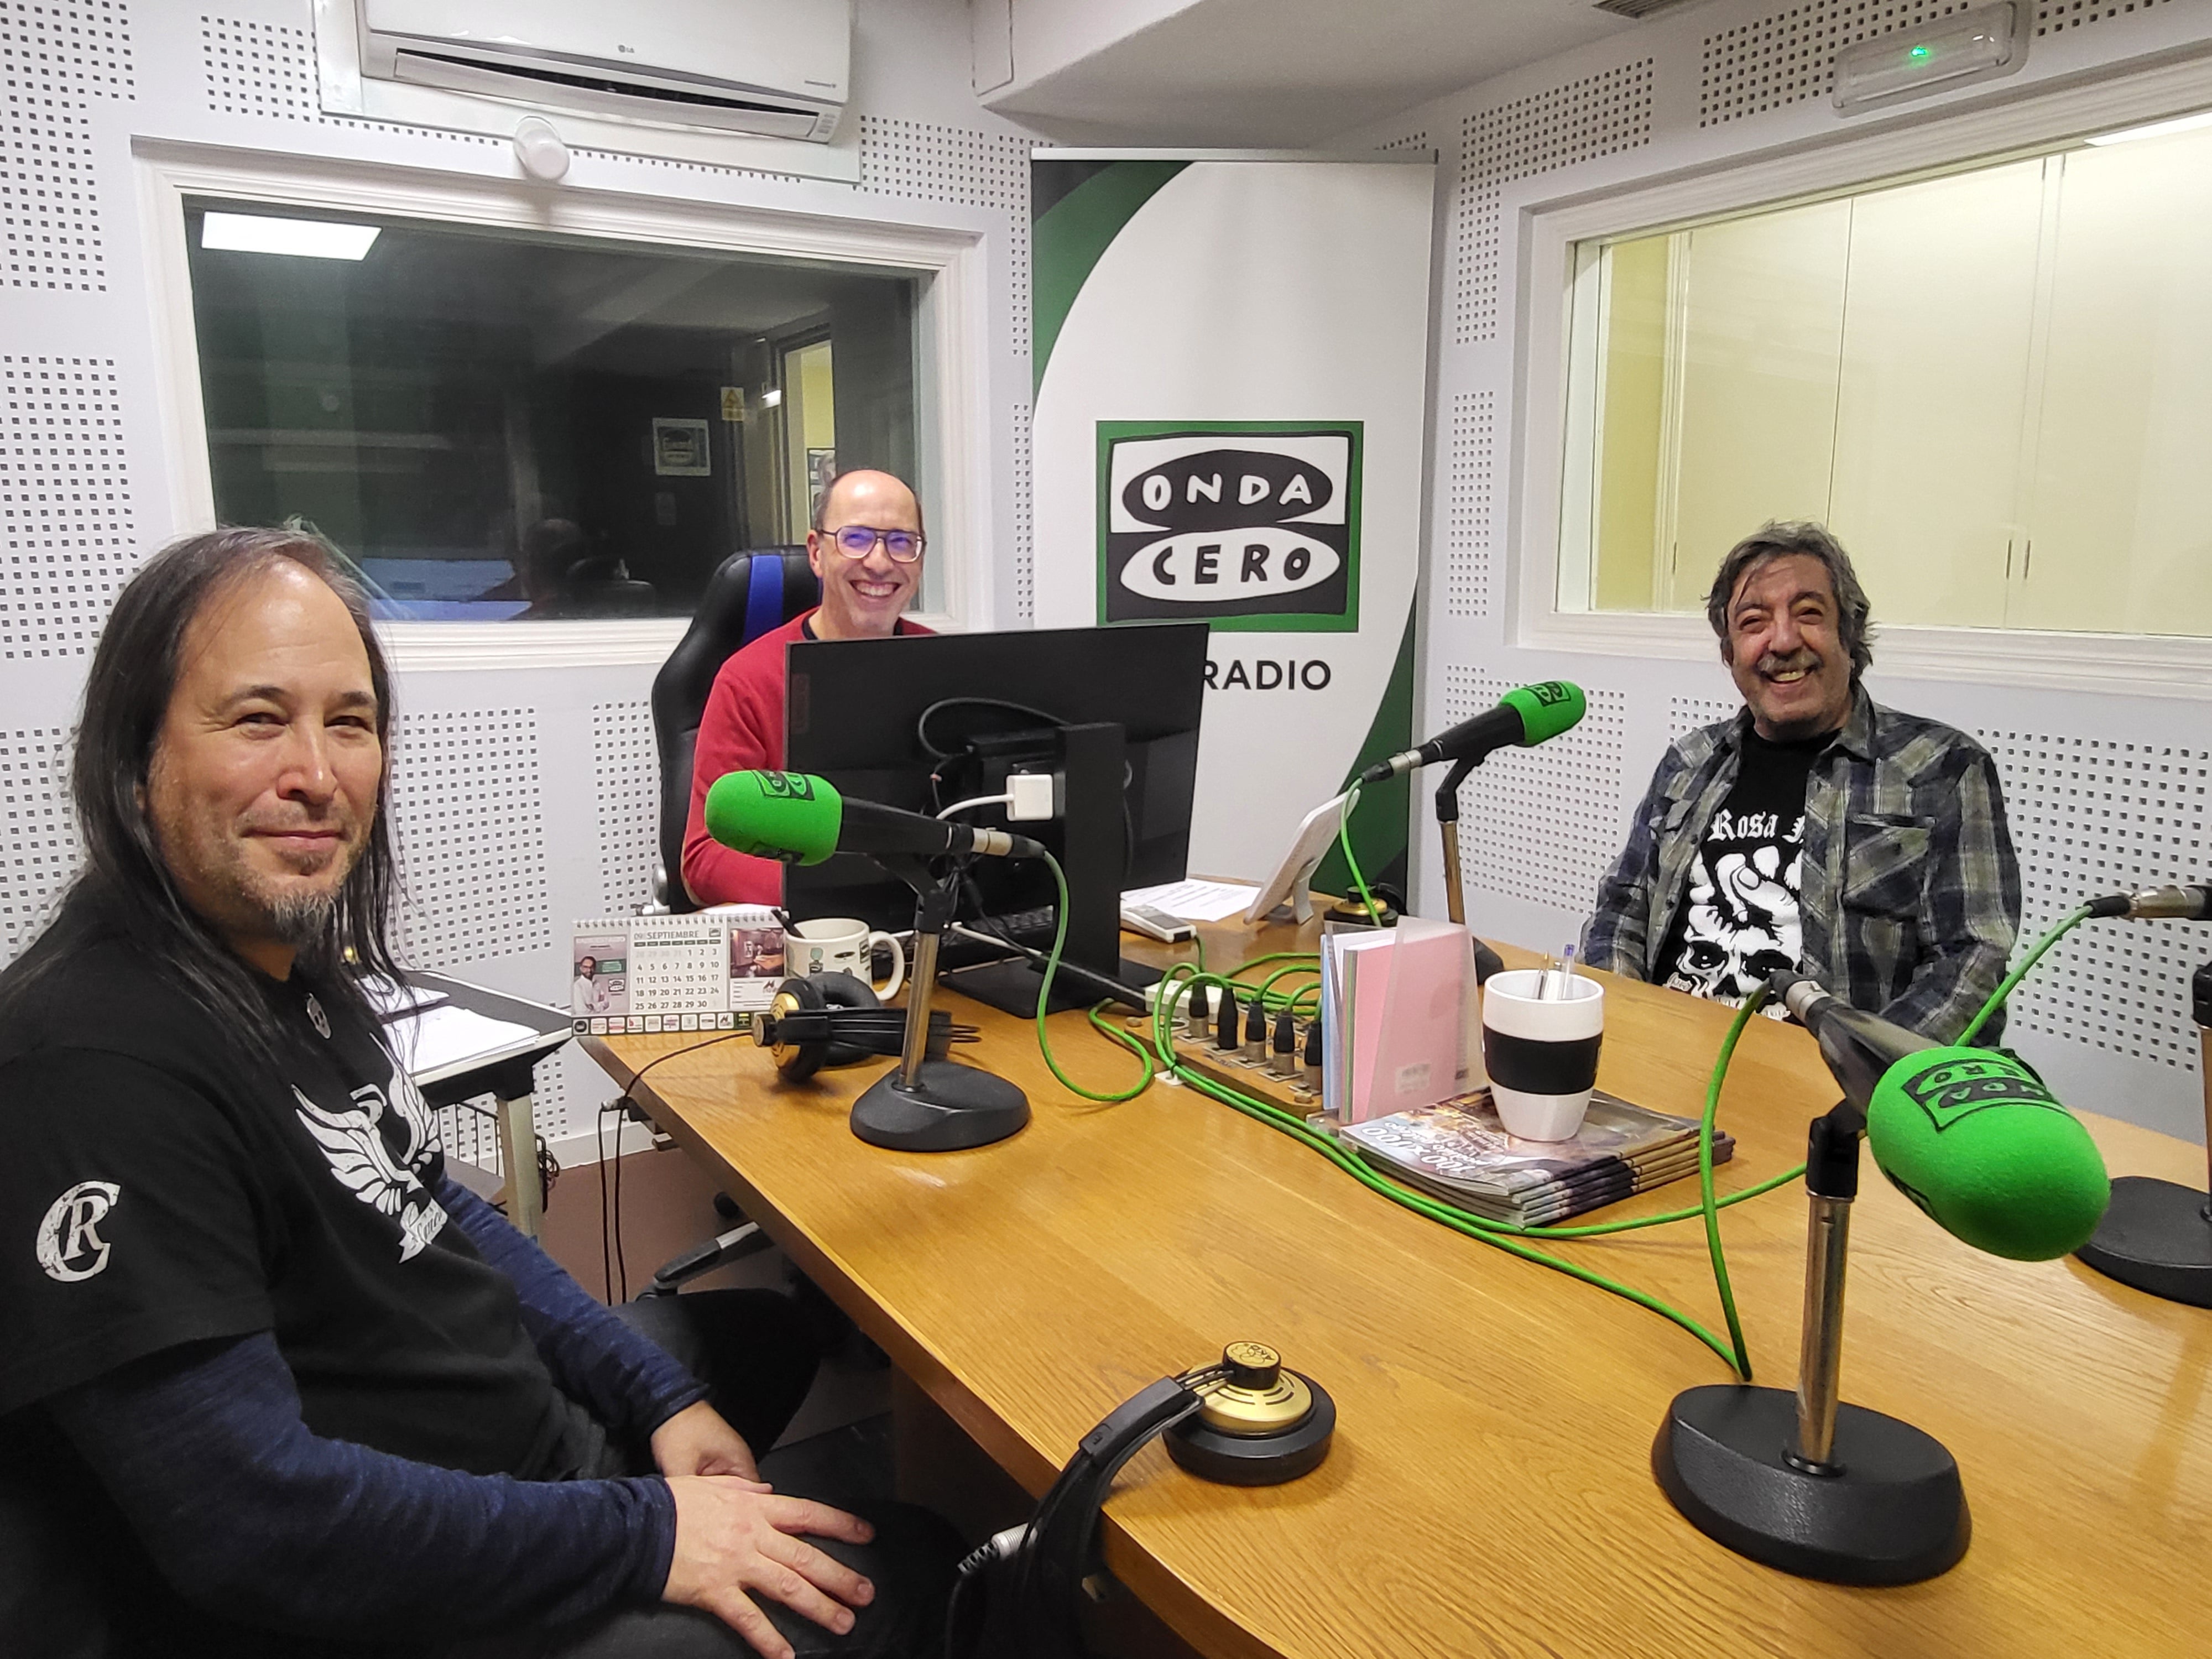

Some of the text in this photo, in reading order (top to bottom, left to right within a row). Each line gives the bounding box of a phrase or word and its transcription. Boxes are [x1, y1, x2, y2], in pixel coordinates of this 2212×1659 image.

[1141, 473, 1312, 511] ONDA
[1152, 544, 1311, 585] CERO
[1203, 660, 1332, 690] RADIO
[1707, 808, 1779, 842] Rosa
[646, 931, 700, 940] SEPTIEMBRE
